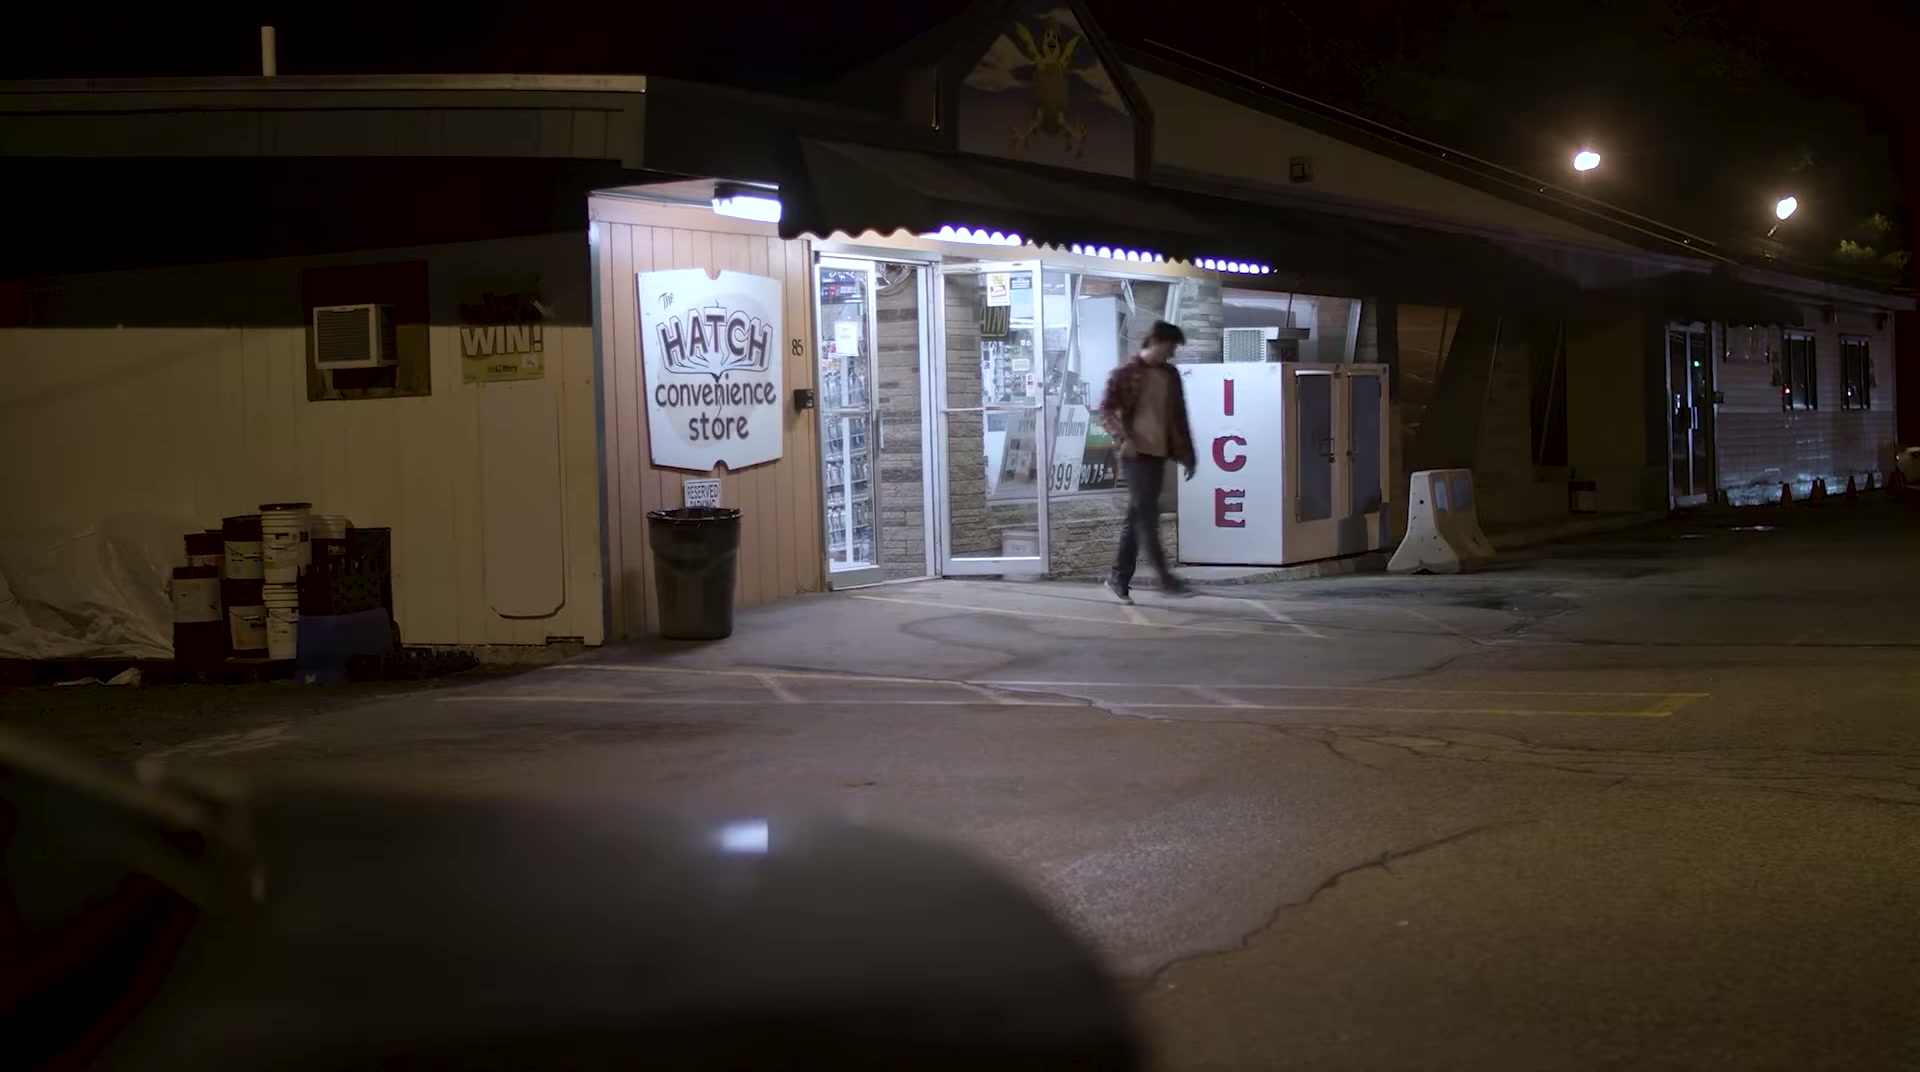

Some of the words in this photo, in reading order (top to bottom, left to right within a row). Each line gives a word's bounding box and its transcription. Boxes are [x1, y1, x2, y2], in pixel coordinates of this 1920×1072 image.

[658, 291, 674, 310] The
[461, 325, 543, 358] WIN!
[656, 308, 773, 370] HATCH
[792, 339, 804, 356] 85
[655, 373, 777, 407] convenience
[689, 411, 749, 440] store
[1212, 374, 1247, 528] ICE
[687, 484, 718, 499] RESERVED
